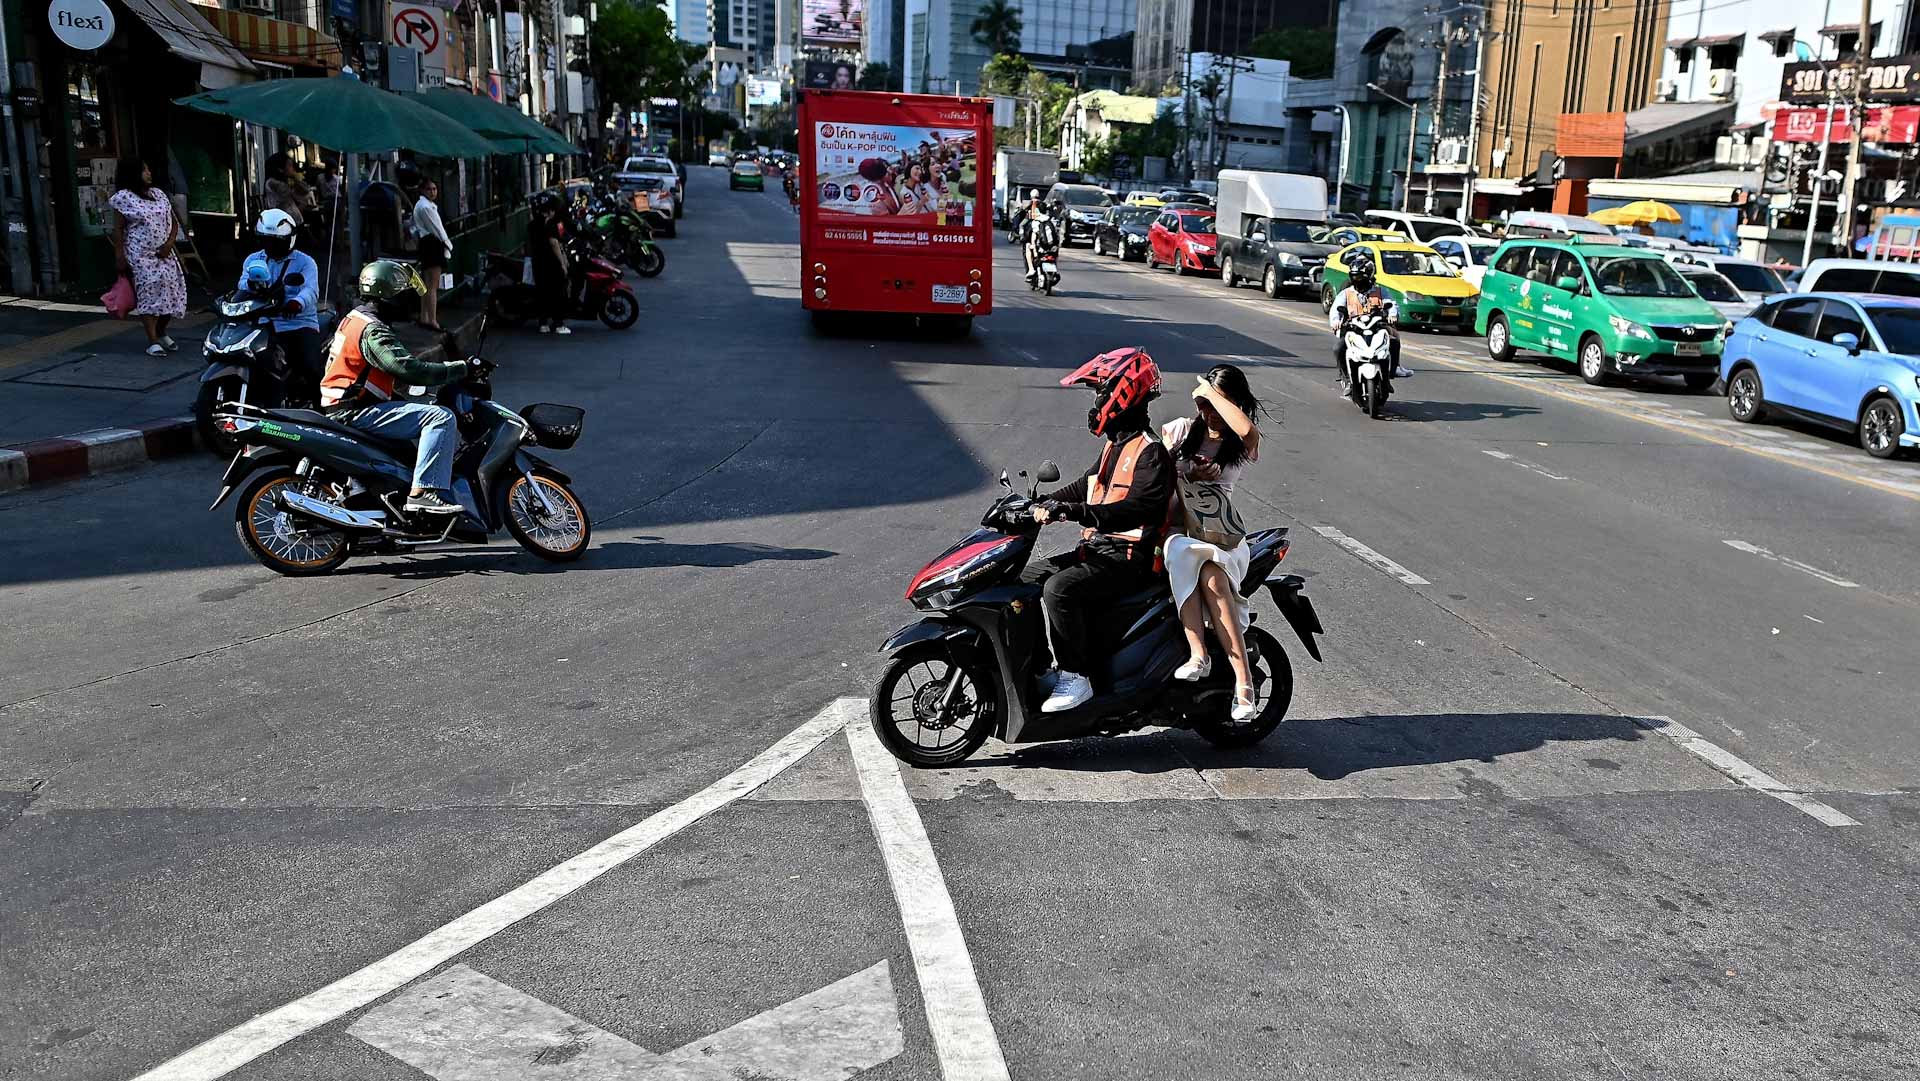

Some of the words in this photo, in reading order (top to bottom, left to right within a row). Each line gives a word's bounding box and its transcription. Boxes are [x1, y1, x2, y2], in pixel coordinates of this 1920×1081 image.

[1794, 70, 1824, 91] SOI
[847, 143, 876, 151] K-POP
[878, 144, 900, 153] IDOL
[932, 234, 975, 243] 62615016
[1121, 456, 1132, 472] 2
